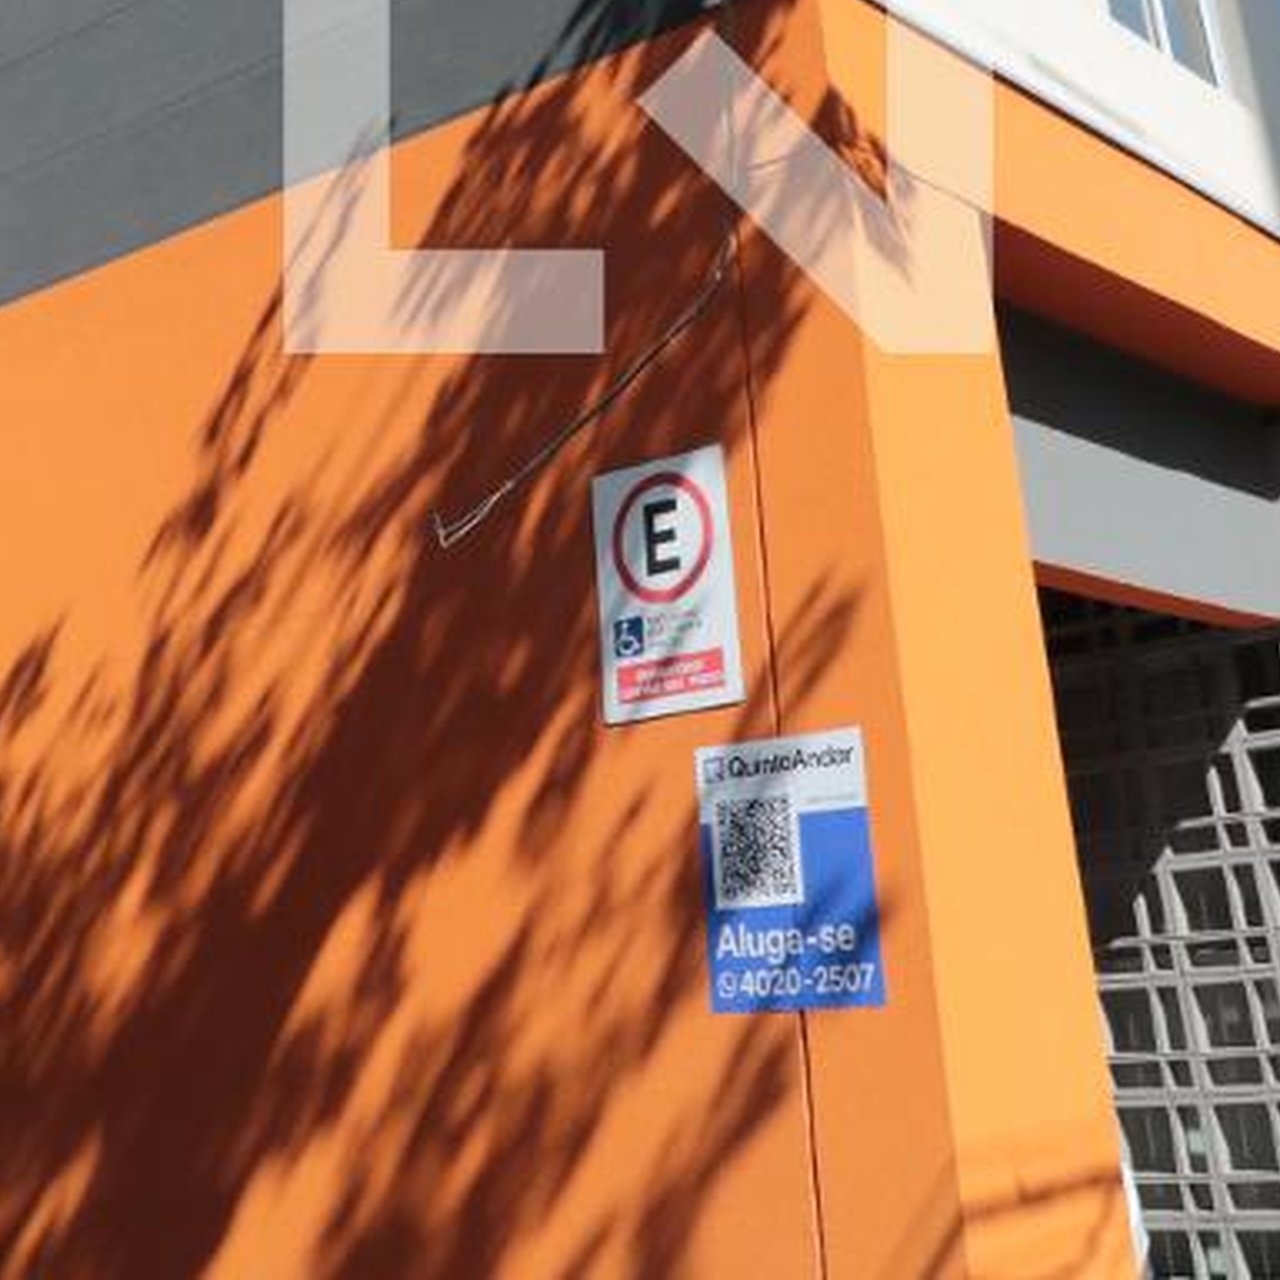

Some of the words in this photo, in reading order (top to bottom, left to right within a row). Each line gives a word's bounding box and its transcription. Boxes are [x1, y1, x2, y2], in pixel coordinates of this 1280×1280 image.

[643, 498, 680, 576] E
[728, 744, 854, 778] QuintoAndar
[716, 922, 856, 965] Aluga-se
[740, 962, 875, 997] 4020-2507
